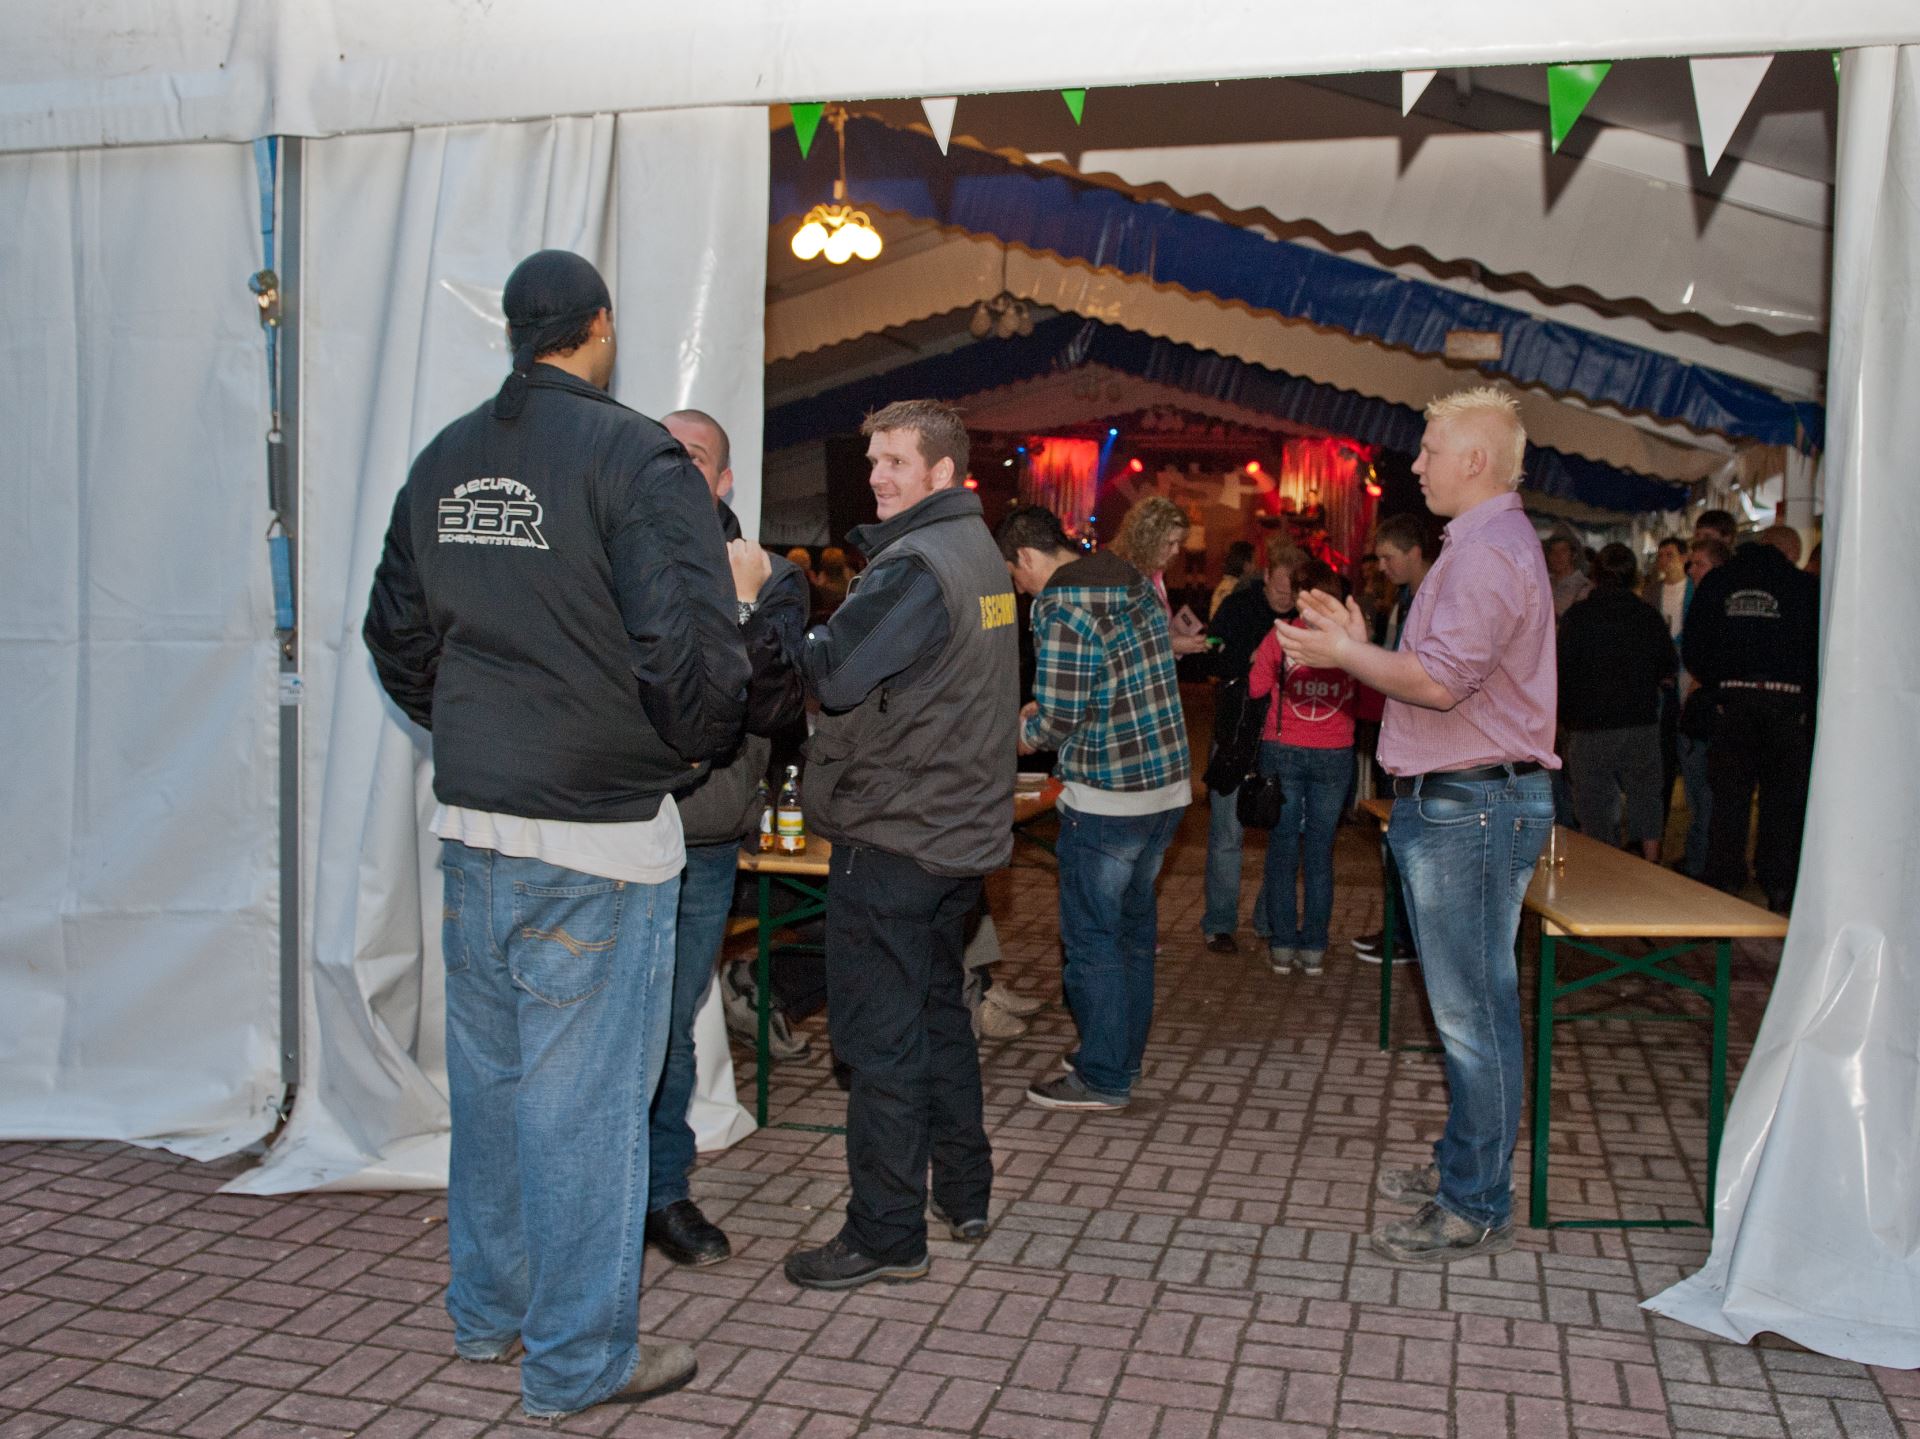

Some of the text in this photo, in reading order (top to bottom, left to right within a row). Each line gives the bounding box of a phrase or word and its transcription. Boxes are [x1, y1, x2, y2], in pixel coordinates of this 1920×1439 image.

[453, 477, 537, 502] SECURITY
[438, 498, 549, 550] BBR
[1293, 680, 1340, 698] 1981
